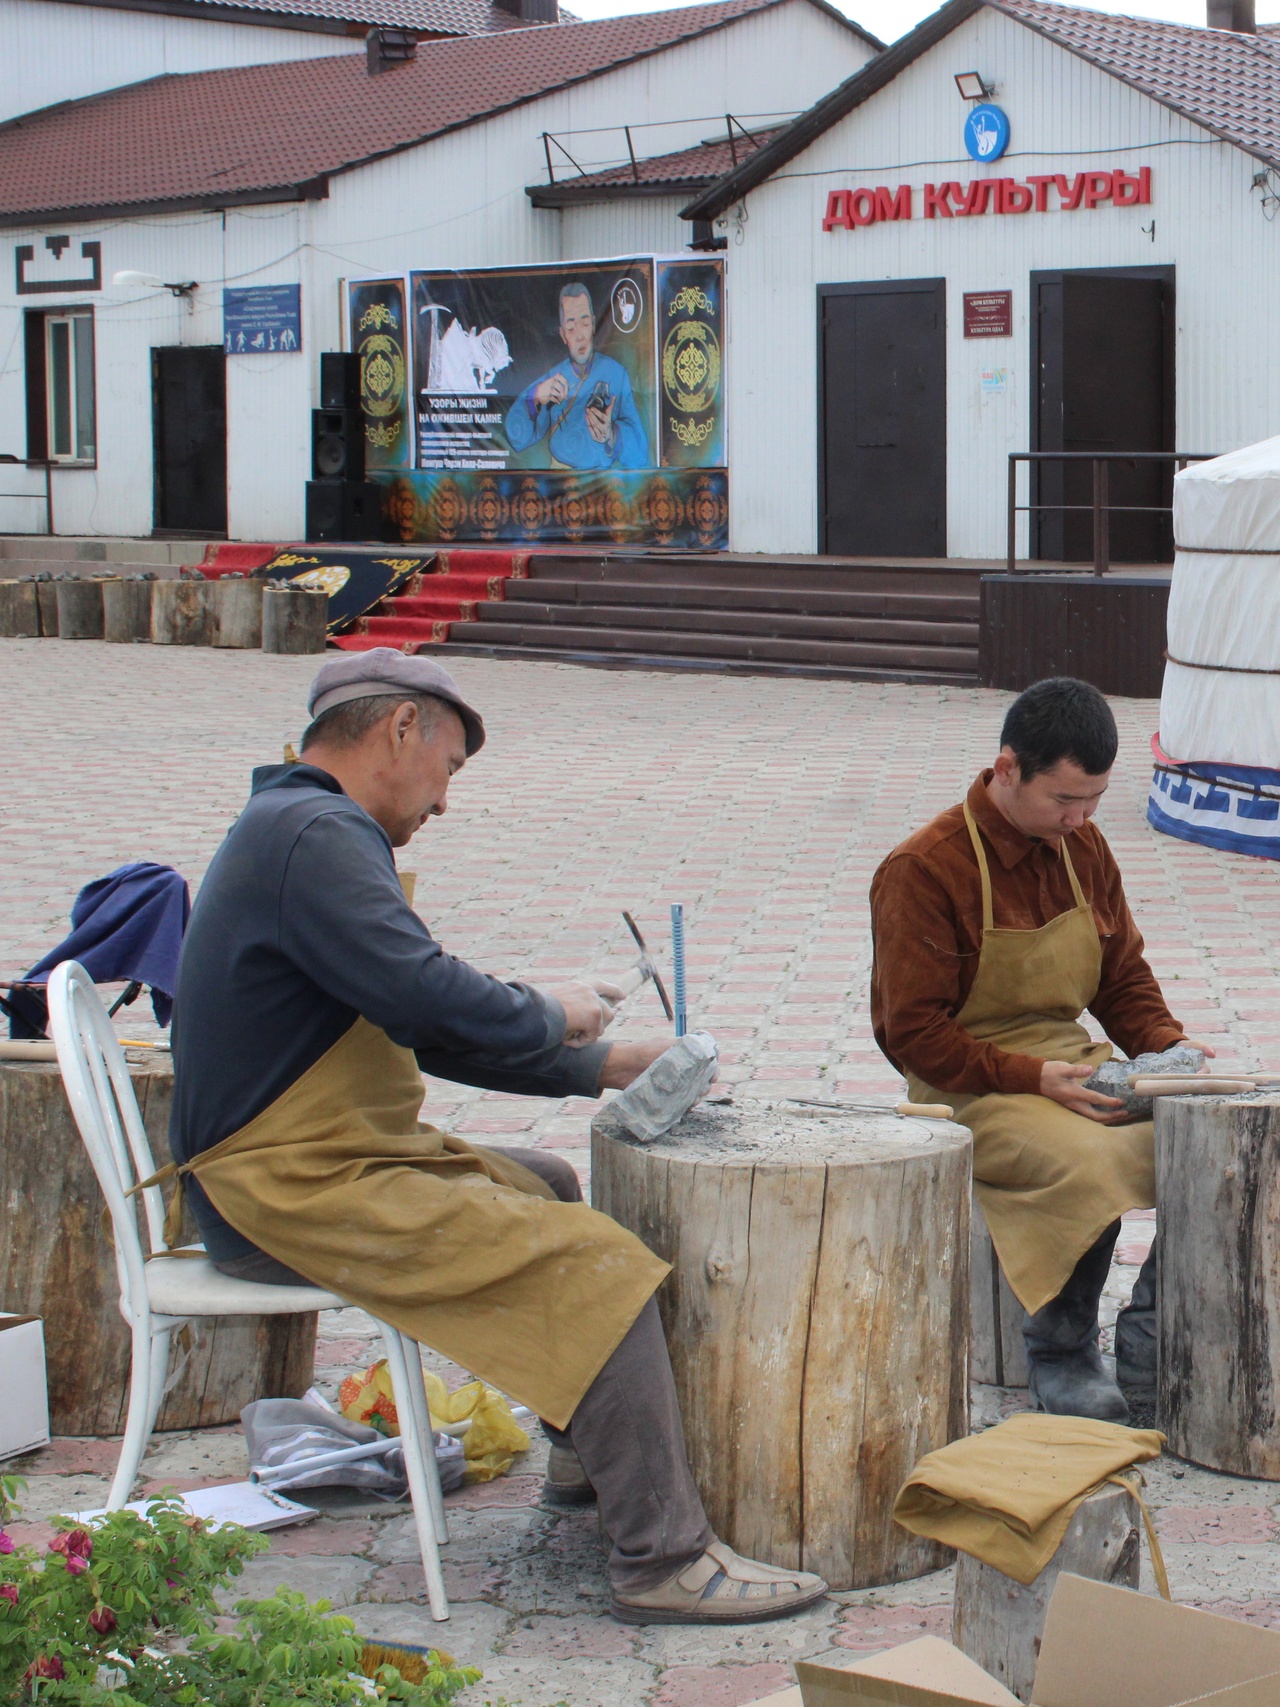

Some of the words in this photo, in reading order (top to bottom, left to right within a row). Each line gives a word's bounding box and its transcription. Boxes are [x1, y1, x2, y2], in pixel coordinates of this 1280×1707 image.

[822, 184, 911, 232] ДОМ
[924, 166, 1152, 219] КУЛЬТУРЫ
[429, 398, 458, 408] УЗОРЫ
[458, 398, 487, 408] ЖИЗНИ
[419, 413, 430, 423] НА
[430, 413, 473, 423] ОЖИВШЕМ
[474, 413, 502, 423] КАМНЕ
